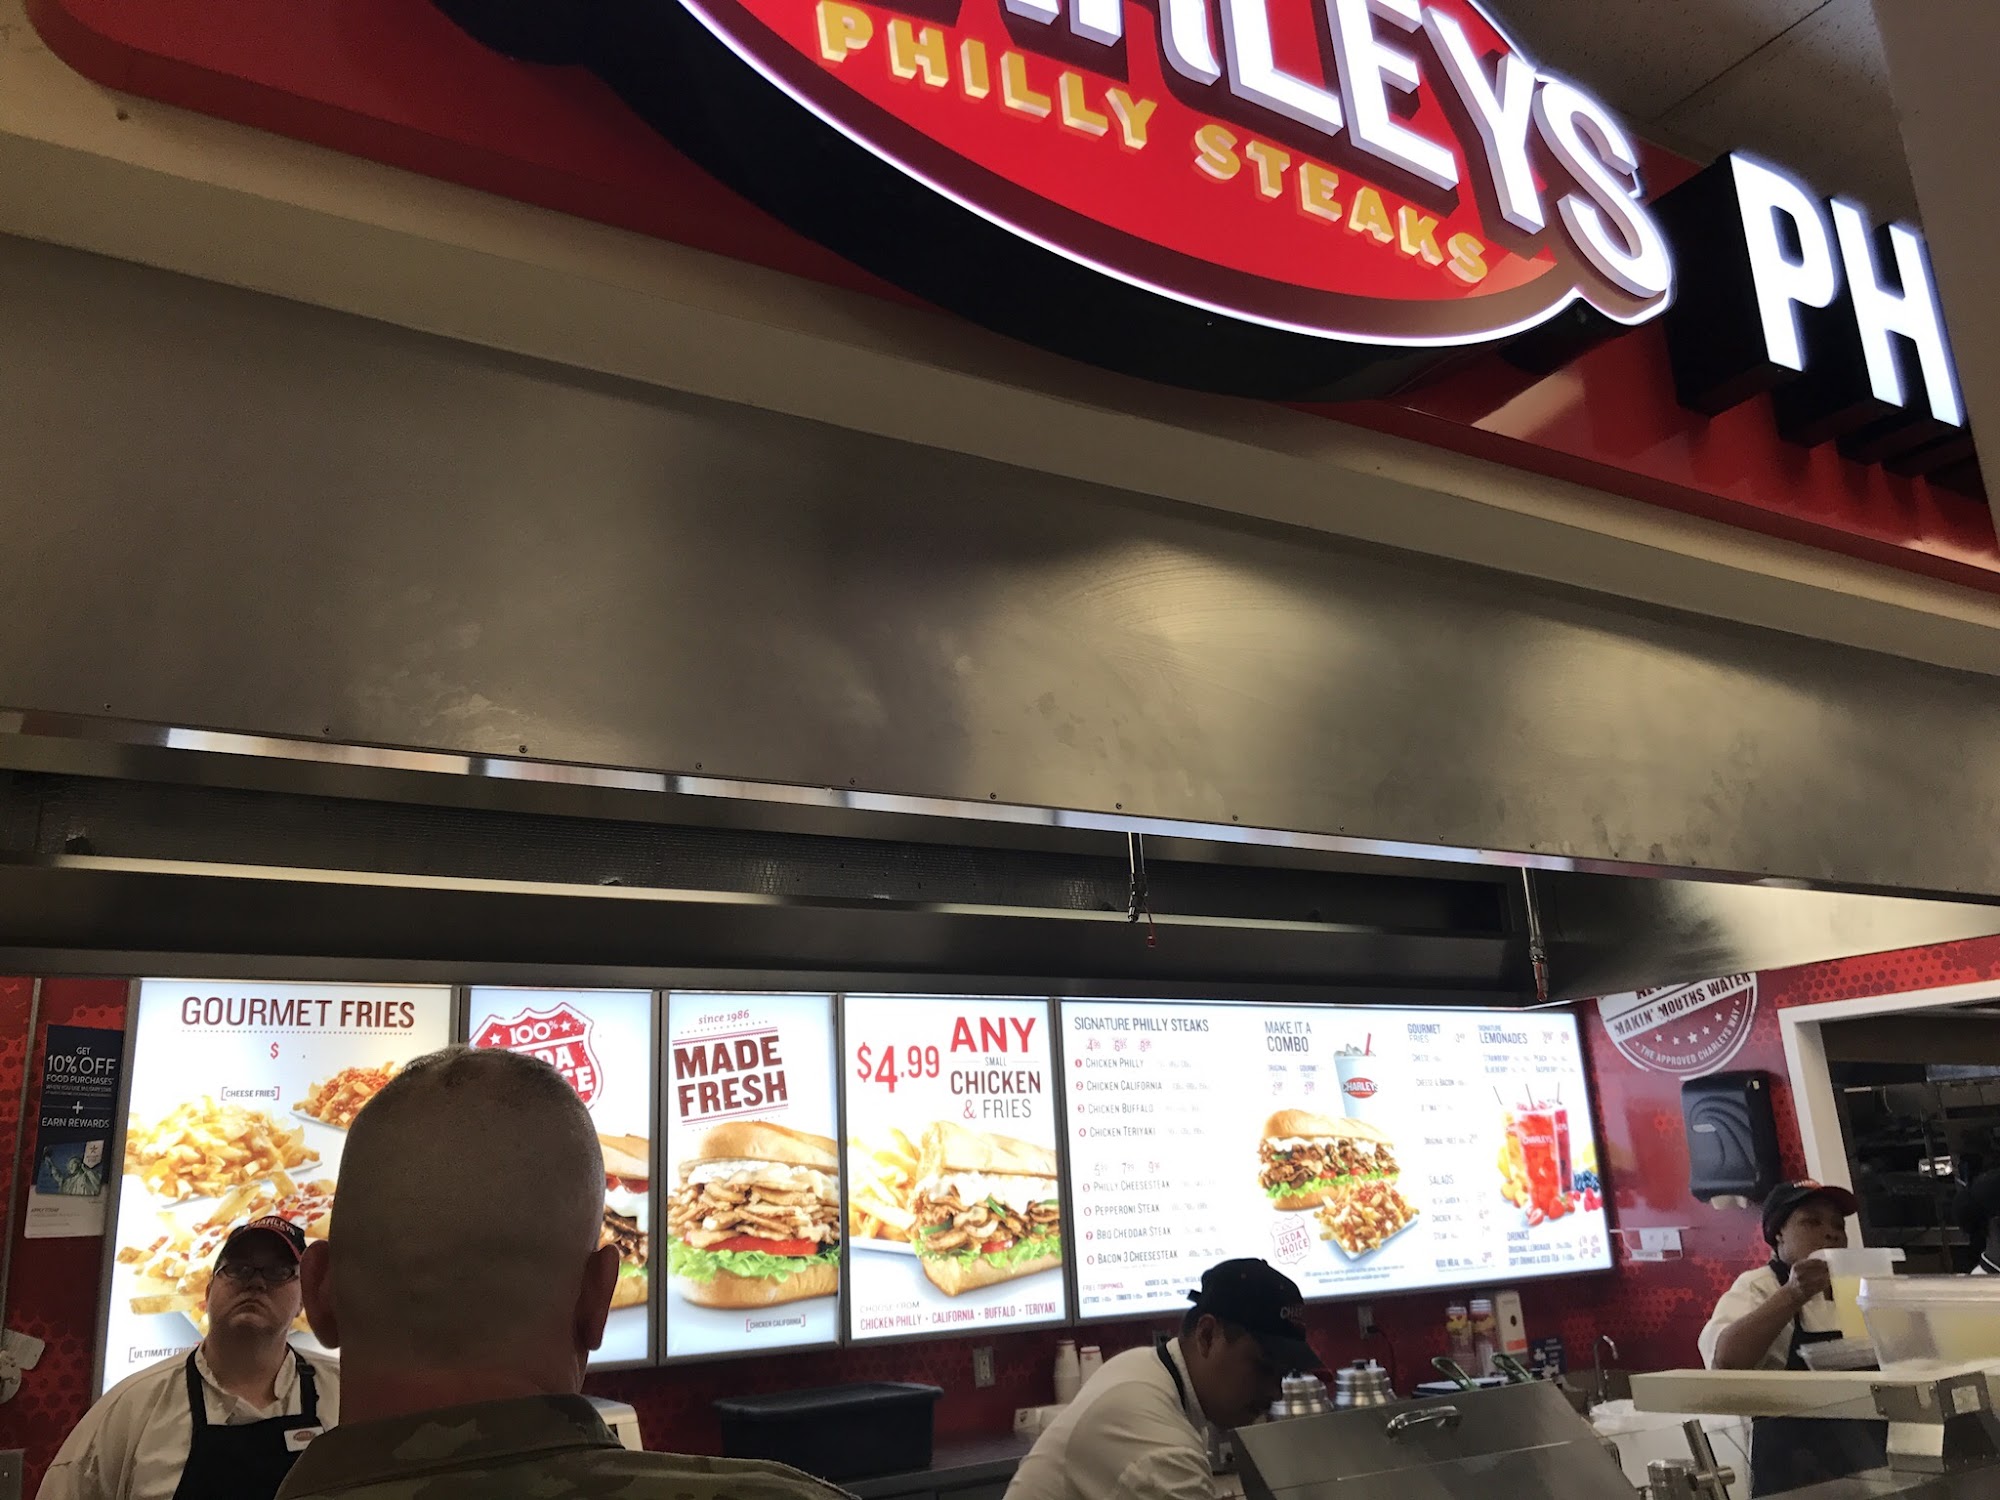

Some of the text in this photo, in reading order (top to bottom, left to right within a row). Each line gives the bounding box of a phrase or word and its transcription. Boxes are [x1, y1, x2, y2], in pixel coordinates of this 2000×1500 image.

[815, 1, 1488, 284] PHILLY STEAKS
[1005, 0, 1672, 300] LEYS
[1730, 151, 1964, 428] PH
[1657, 988, 1706, 1018] MOUTHS
[1707, 972, 1751, 997] WATER
[180, 996, 415, 1028] GOURMET FRIES
[698, 1009, 750, 1025] since 1986
[509, 1020, 558, 1045] 100%
[1074, 1016, 1209, 1032] SIGNATURE PHILLY STEAKS
[1264, 1021, 1312, 1034] MAKE IT A
[1407, 1024, 1441, 1035] GOURMET
[950, 1017, 1036, 1052] ANY
[1267, 1036, 1309, 1052] COMBO
[1480, 1032, 1528, 1044] LEMONADES
[1640, 1008, 1741, 1067] THE APPROVED CHARLEYS WAY
[76, 1047, 91, 1055] GET
[674, 1035, 782, 1080] MADE
[47, 1054, 116, 1075] 10% OFF
[857, 1042, 940, 1093] $4.99
[985, 1056, 1006, 1067] SMALL
[46, 1074, 70, 1083] FOOD
[951, 1070, 1041, 1094] CHICKEN
[254, 1088, 276, 1098] FRIES
[677, 1071, 788, 1117] FRESH
[963, 1099, 1032, 1119] & FRIES
[42, 1117, 110, 1128] EARN REWARDS
[1277, 1238, 1309, 1258] CHOICE
[1279, 1230, 1302, 1246] USDA
[860, 1301, 1056, 1330] CHICKEN PHILLY CALIFORNIA BUFFALO TERIYAKI
[134, 1347, 172, 1359] ULTIMATE
